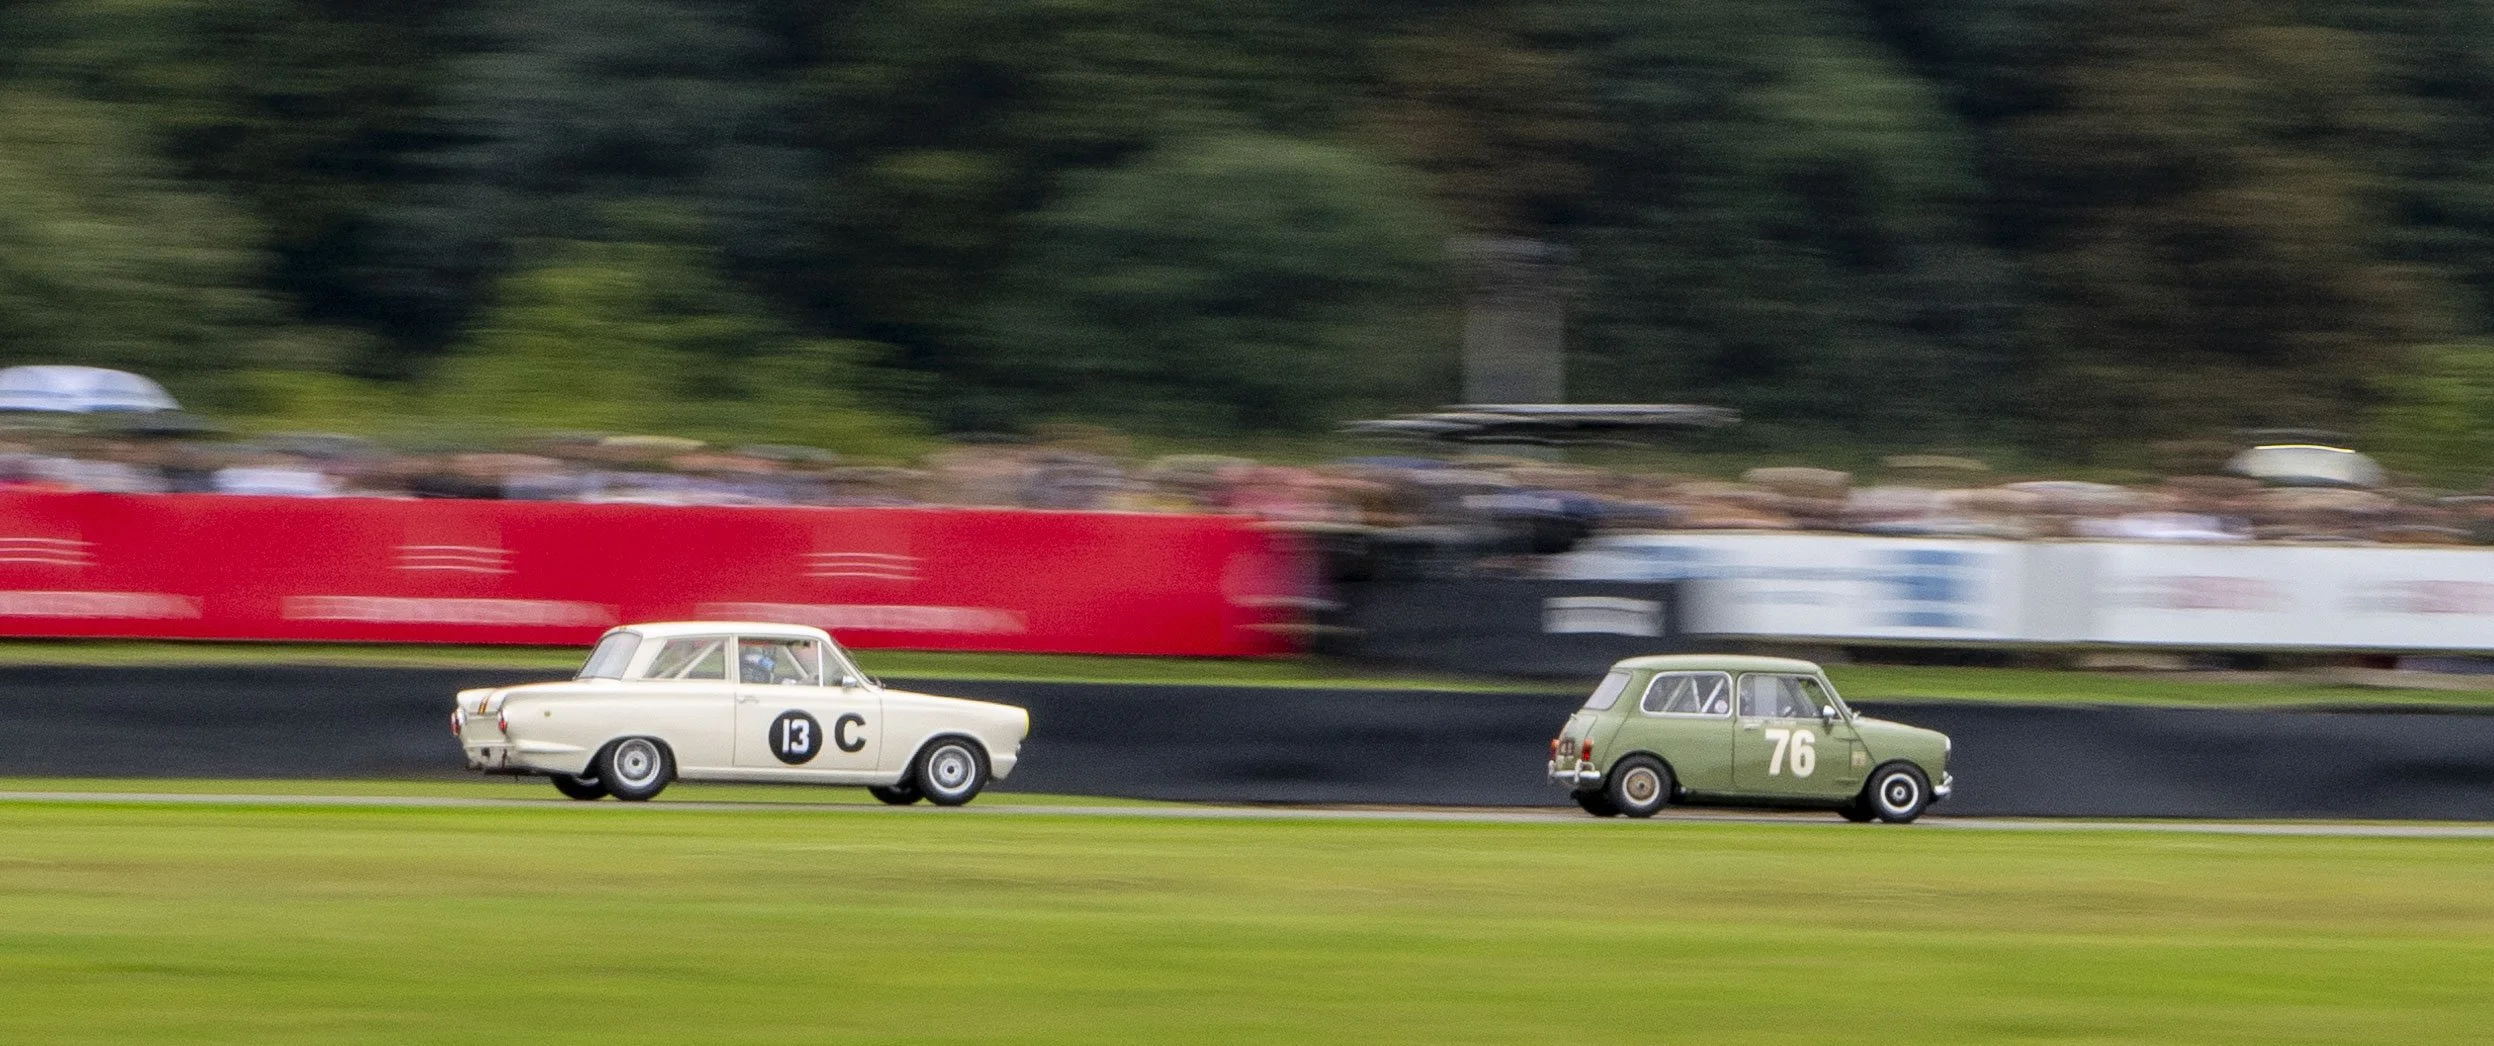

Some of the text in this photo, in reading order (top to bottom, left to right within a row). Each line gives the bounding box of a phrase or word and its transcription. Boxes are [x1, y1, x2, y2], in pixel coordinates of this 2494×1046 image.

[782, 712, 867, 754] 13 C
[1765, 728, 1816, 779] 76
